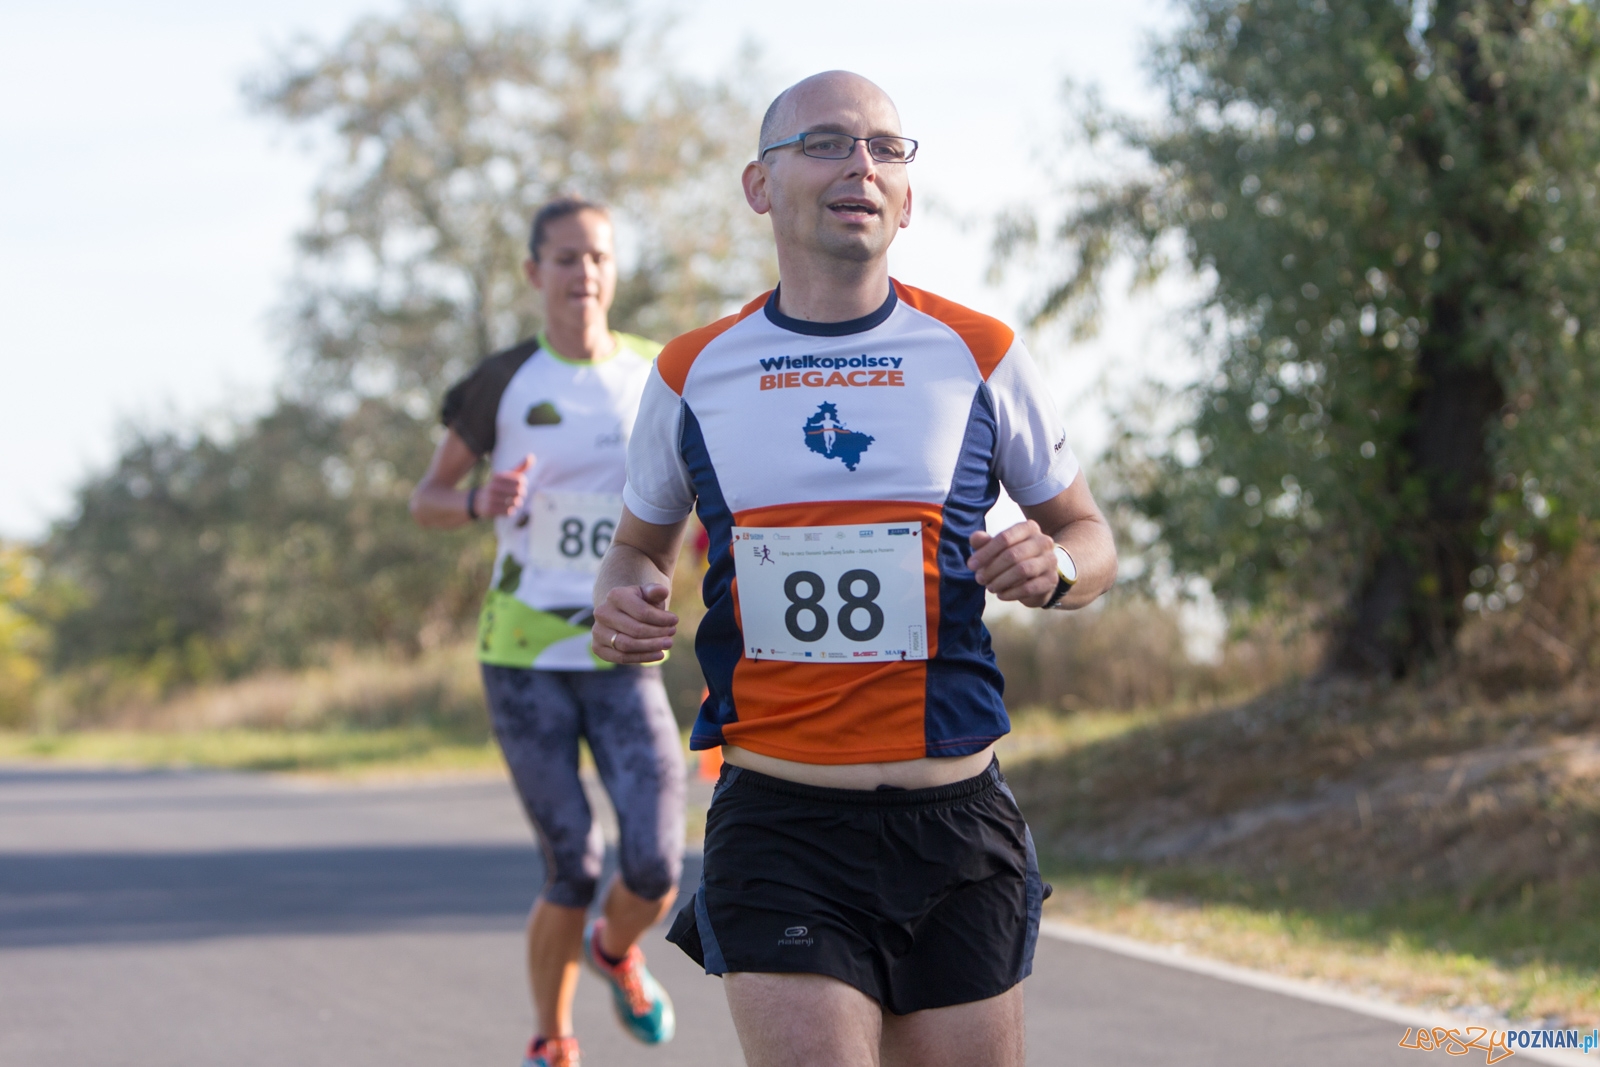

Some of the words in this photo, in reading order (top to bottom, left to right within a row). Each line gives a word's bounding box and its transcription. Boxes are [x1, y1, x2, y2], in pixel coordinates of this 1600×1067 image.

[760, 354, 903, 372] Wielkopolscy
[760, 370, 905, 391] BIEGACZE
[560, 518, 614, 559] 86
[784, 569, 884, 642] 88
